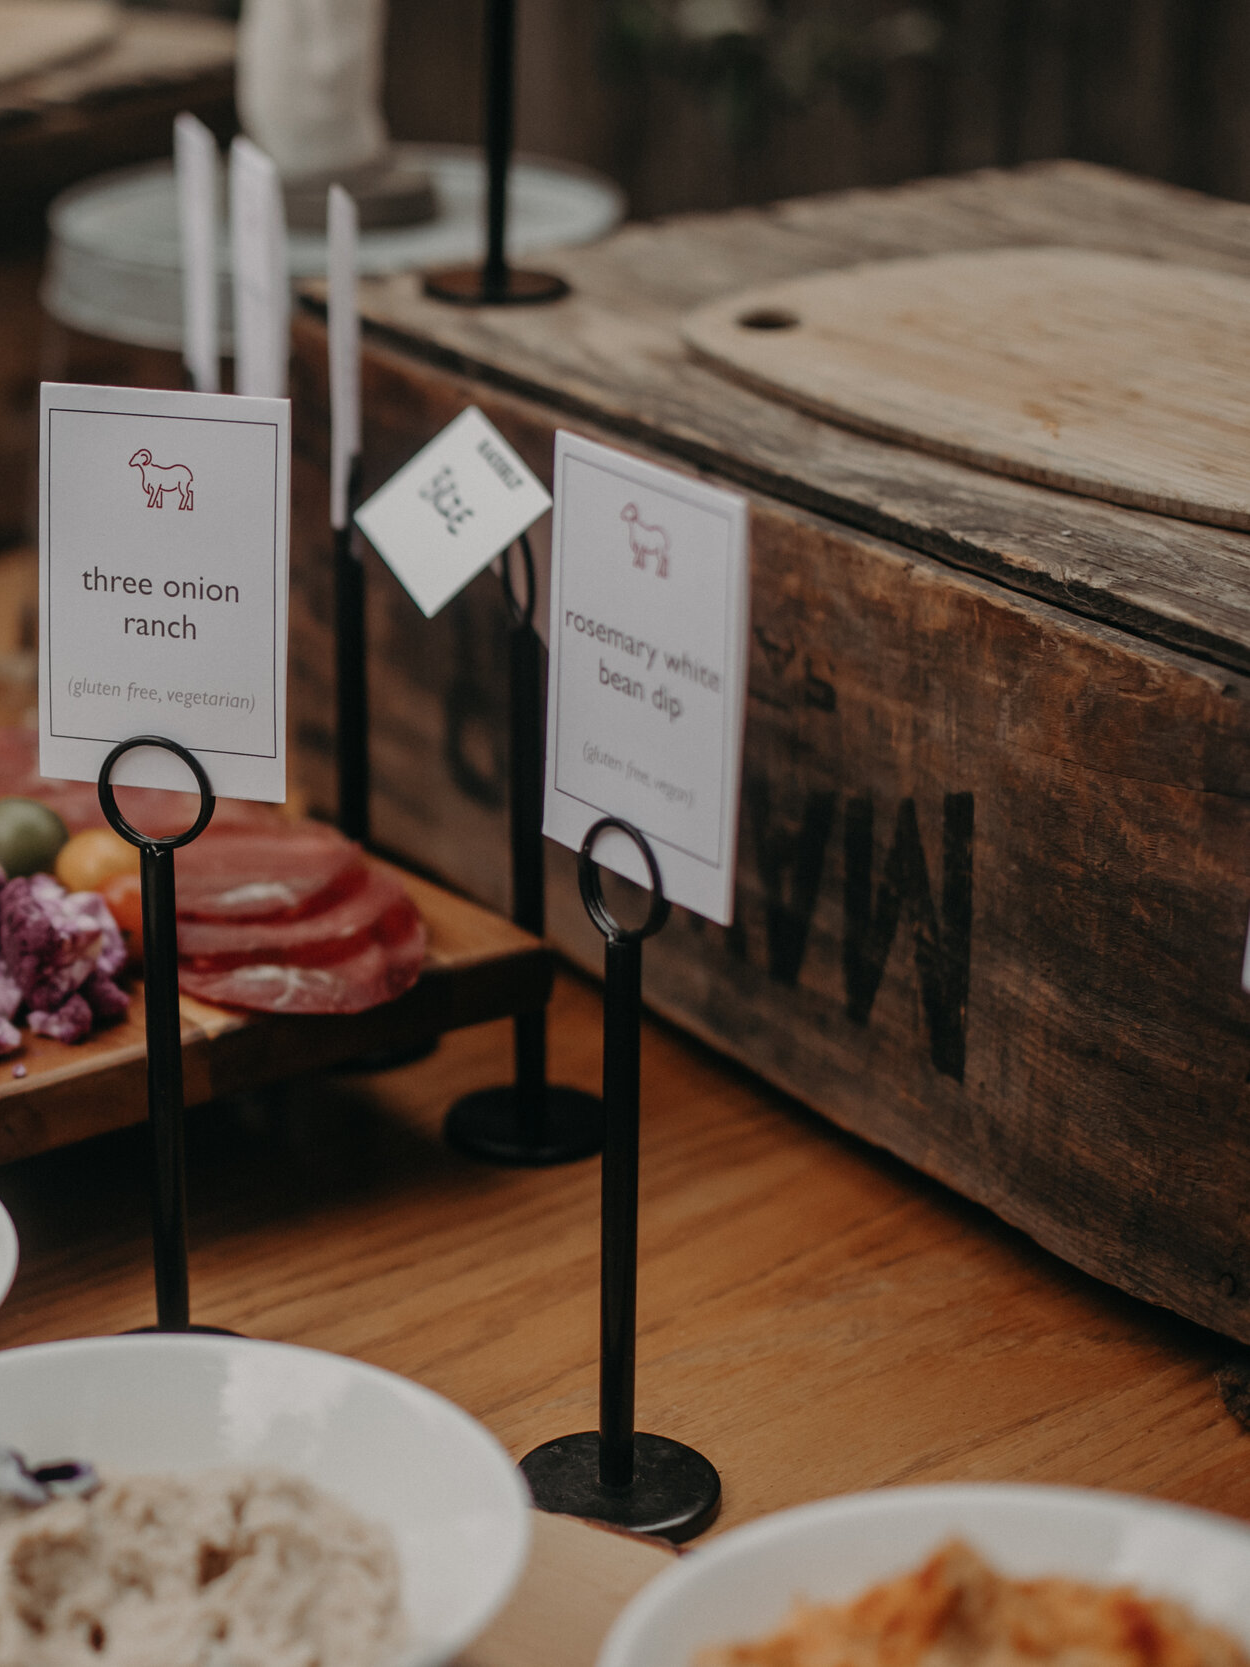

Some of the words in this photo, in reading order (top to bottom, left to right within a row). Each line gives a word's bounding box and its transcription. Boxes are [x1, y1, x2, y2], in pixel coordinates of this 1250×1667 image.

[82, 567, 153, 595] three
[163, 577, 240, 603] onion
[124, 615, 197, 640] ranch
[565, 609, 658, 670] rosemary
[664, 651, 721, 693] white
[67, 676, 121, 698] (gluten
[127, 681, 162, 702] free,
[167, 688, 255, 712] vegetarian)
[598, 659, 645, 701] bean
[652, 686, 683, 723] dip
[583, 740, 623, 774] (gluten
